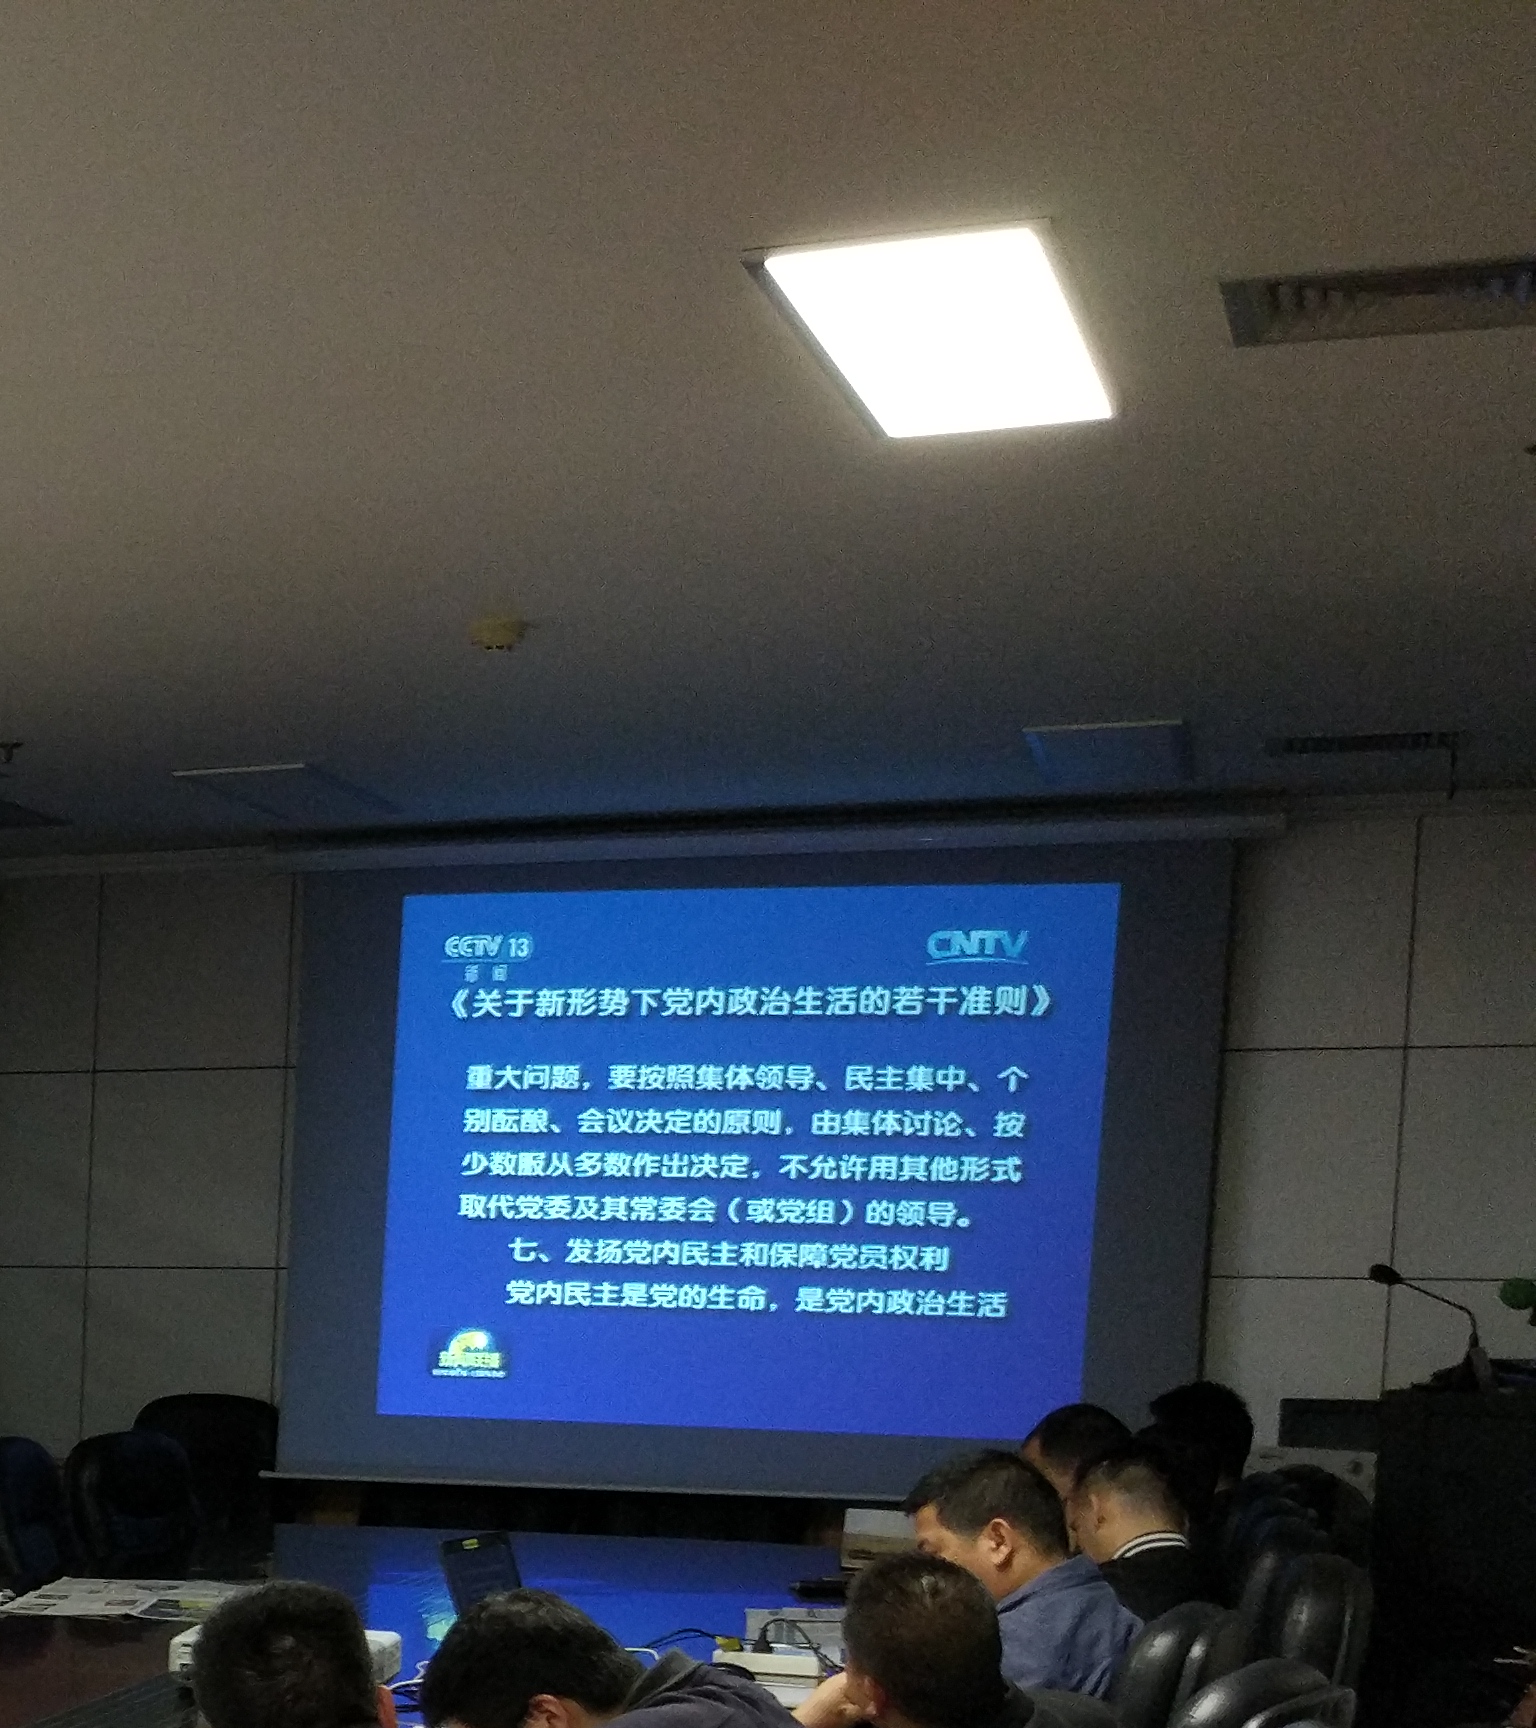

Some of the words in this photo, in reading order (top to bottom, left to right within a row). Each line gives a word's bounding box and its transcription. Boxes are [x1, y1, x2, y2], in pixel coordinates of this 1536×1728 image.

[444, 934, 504, 957] CCTV
[508, 938, 530, 957] 13
[927, 929, 1029, 961] CNTV
[450, 985, 1054, 1019] 《关于新形势下党内政治生活的若干准则》
[465, 1064, 1029, 1094] 重大问题，要按照集体领导、民主集中、个
[463, 1108, 1026, 1139] 别酝酿、会议决定的原则，由集体讨论、按
[460, 1152, 1022, 1184] 少数服从多数作出决定，不允许用其他形式
[458, 1194, 974, 1230] 取代党委及其常委会（或党组）的领导。
[508, 1238, 950, 1273] 七、发扬党内民主和保障党员权利
[505, 1279, 1009, 1319] 党内民主是党的生命，是党内政治生活
